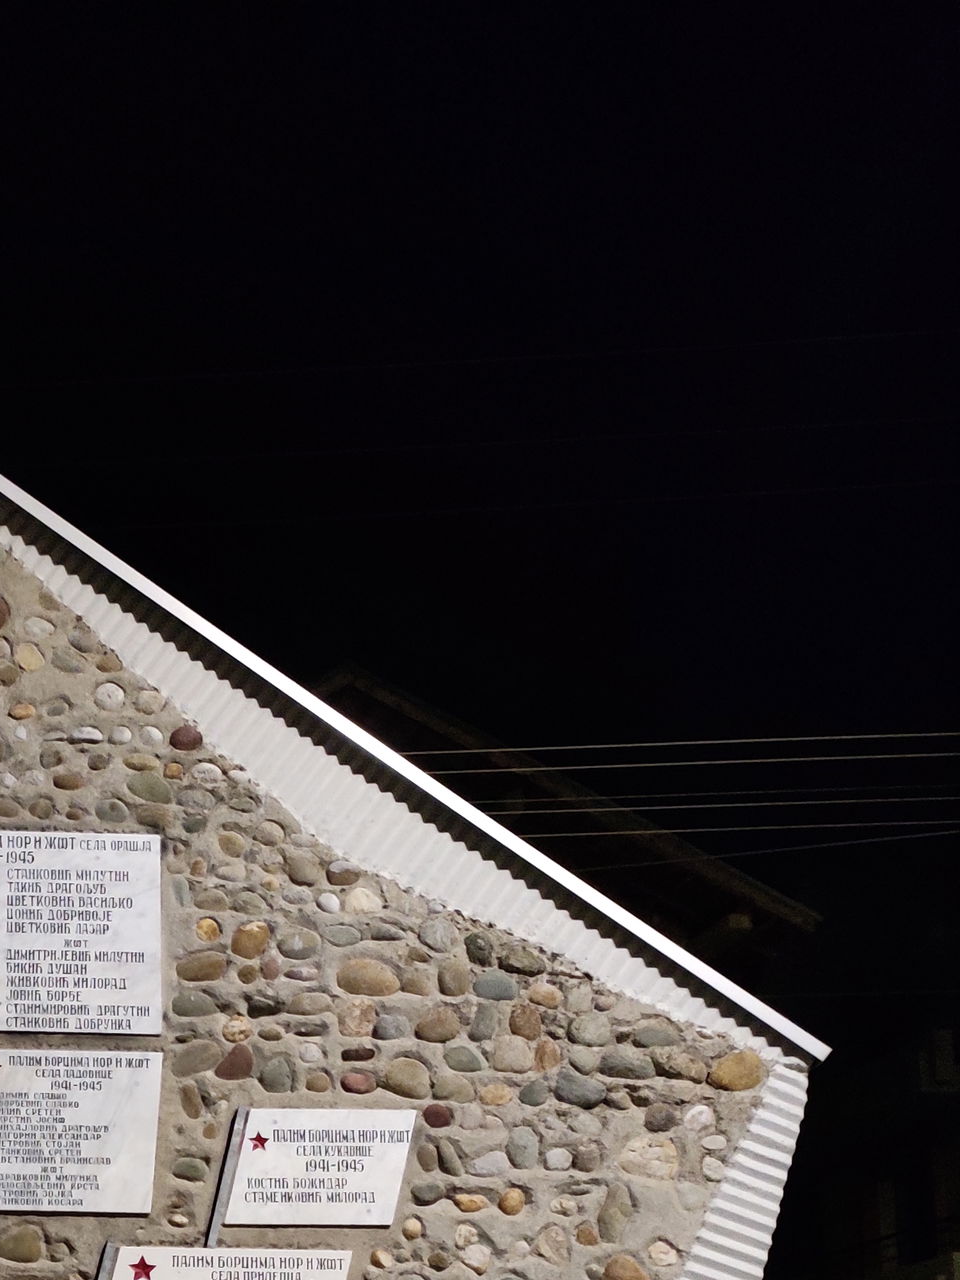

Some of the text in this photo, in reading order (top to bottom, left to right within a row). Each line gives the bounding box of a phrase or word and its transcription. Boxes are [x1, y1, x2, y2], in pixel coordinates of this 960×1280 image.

[8, 836, 31, 848] НОР
[80, 840, 106, 851] СЕЛА
[111, 840, 151, 851] ОРАШЈА
[7, 869, 129, 881] СТАНКОВИЋ МИЛУТИН
[7, 895, 75, 907] ЦВЕТКОВИЋ
[47, 910, 112, 922] ДОБРИВОЈЕ
[6, 922, 109, 935] ЦВЕТКОВИЋ ЛАЗАР
[95, 951, 145, 963] МИЛУТИН
[47, 964, 87, 975] ДУШАН
[73, 978, 127, 989] МИЛОРАД
[6, 990, 41, 1001] ЈОВИЋ
[6, 1017, 69, 1028] СТАНКОВИЋ
[35, 1069, 61, 1078] СЕЛА
[308, 1130, 355, 1143] БОРЦИМА
[247, 1178, 288, 1189] КОСТИЋ
[327, 1192, 376, 1203] МИЛОРАД
[218, 1256, 276, 1269] БОРЦИМА
[279, 1257, 303, 1269] НОР
[211, 1271, 240, 1280] СЕЛА
